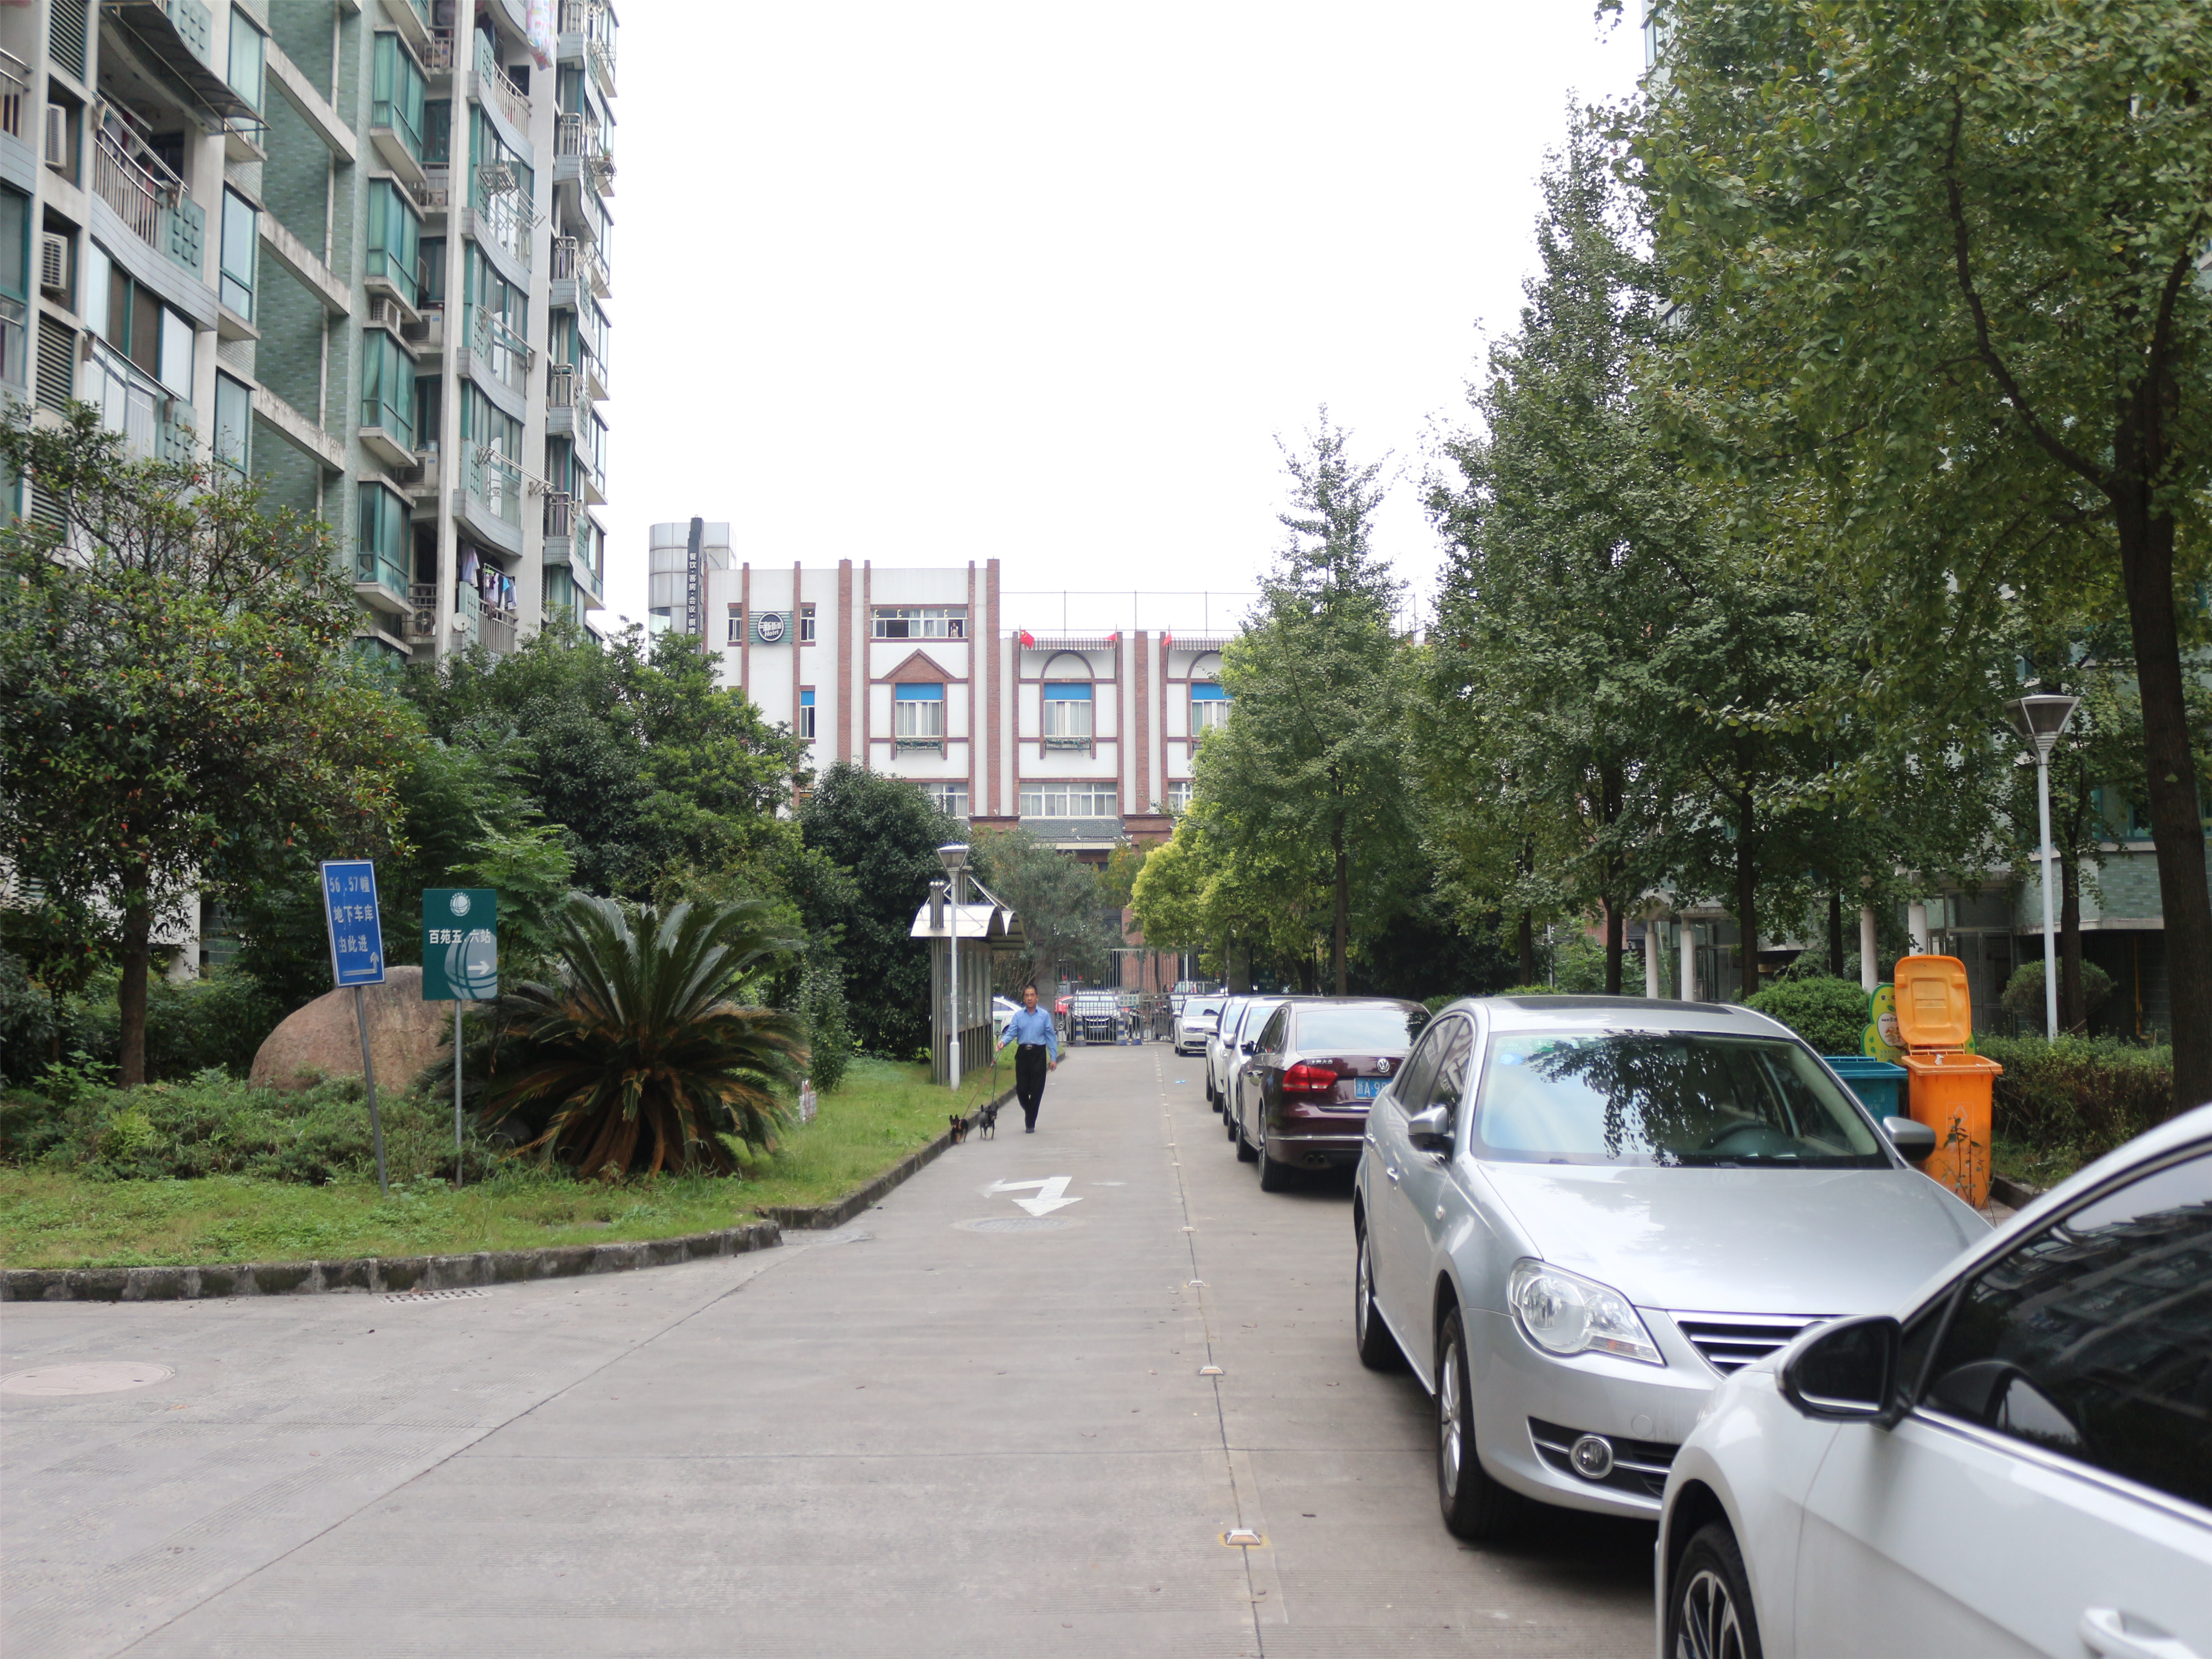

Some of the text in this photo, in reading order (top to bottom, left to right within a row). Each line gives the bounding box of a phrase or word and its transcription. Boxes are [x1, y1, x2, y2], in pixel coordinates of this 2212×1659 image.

[333, 904, 374, 924] 地下车库
[338, 935, 368, 953] 由此进
